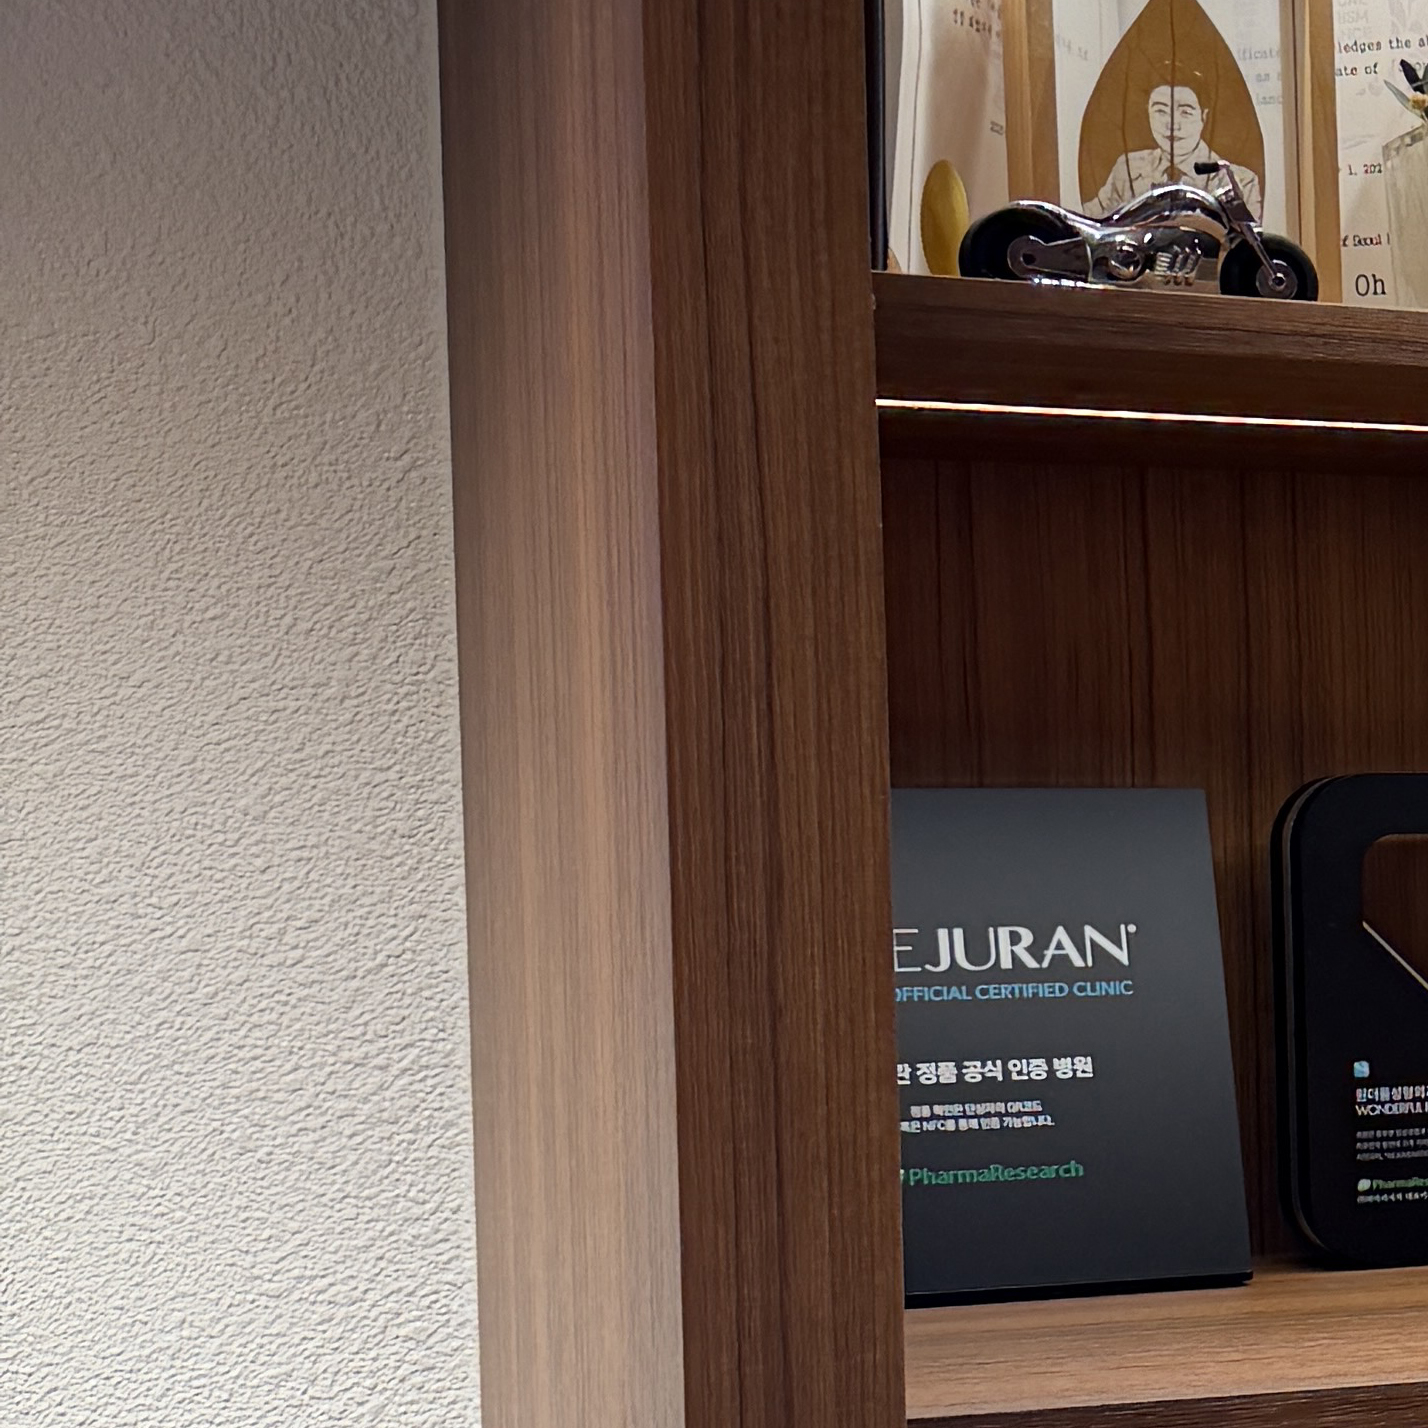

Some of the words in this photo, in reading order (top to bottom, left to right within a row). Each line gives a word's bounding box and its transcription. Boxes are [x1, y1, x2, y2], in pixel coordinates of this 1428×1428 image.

[1389, 35, 1412, 52] the
[1354, 274, 1386, 297] Oh
[893, 924, 1135, 972] EJURAN
[975, 982, 1069, 1000] CERTIFIED
[1073, 980, 1134, 997] CLINIC
[916, 1061, 958, 1085] 정품
[962, 1059, 1003, 1083] 공식
[1007, 1058, 1048, 1081] 인증
[1052, 1056, 1094, 1079] 병원
[909, 1160, 1084, 1186] PharmaResearch
